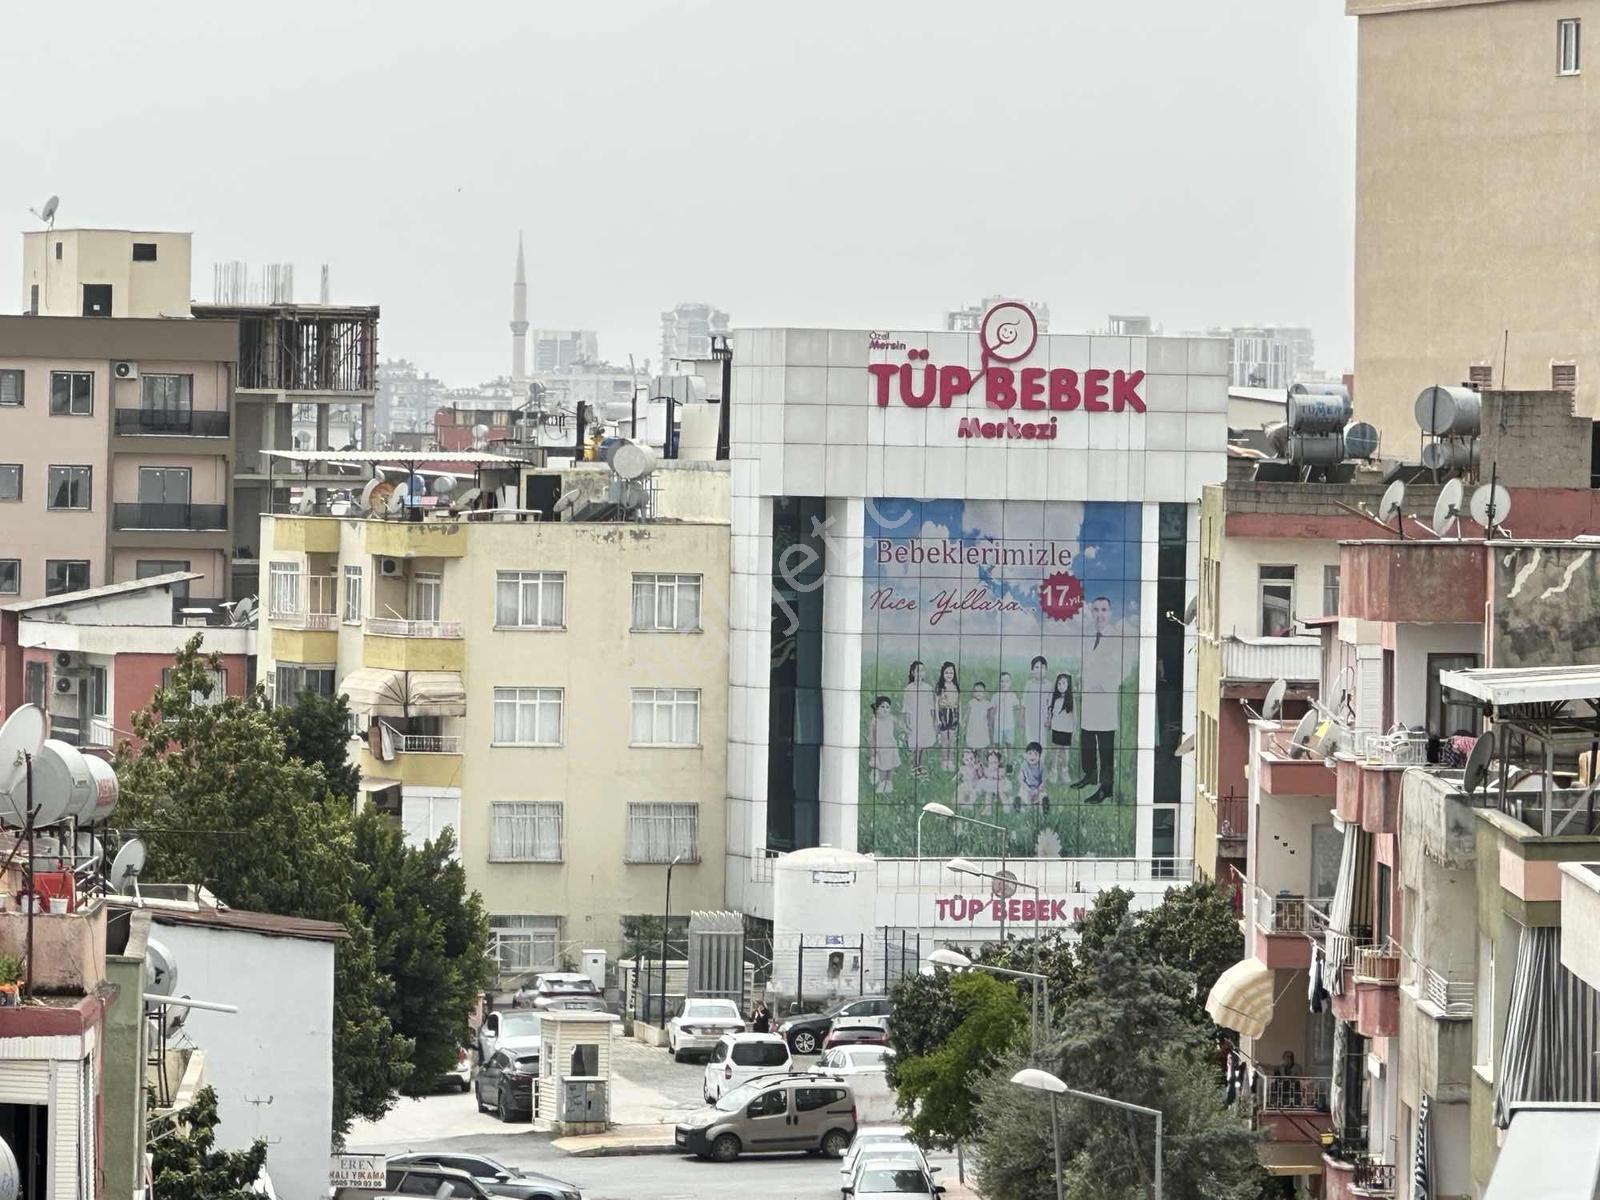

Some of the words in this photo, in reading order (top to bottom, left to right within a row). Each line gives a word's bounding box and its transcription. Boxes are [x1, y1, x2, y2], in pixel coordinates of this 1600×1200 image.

[868, 339, 906, 350] Mersin
[868, 348, 971, 408] TÜP
[986, 367, 1147, 413] BEBEK
[958, 416, 1057, 440] Merkezi
[876, 537, 1072, 567] Bebeklerimizle
[936, 894, 984, 921] TÜP
[992, 899, 1067, 921] BEBEK
[341, 1159, 375, 1170] EREN
[351, 1171, 385, 1180] YIKAMA
